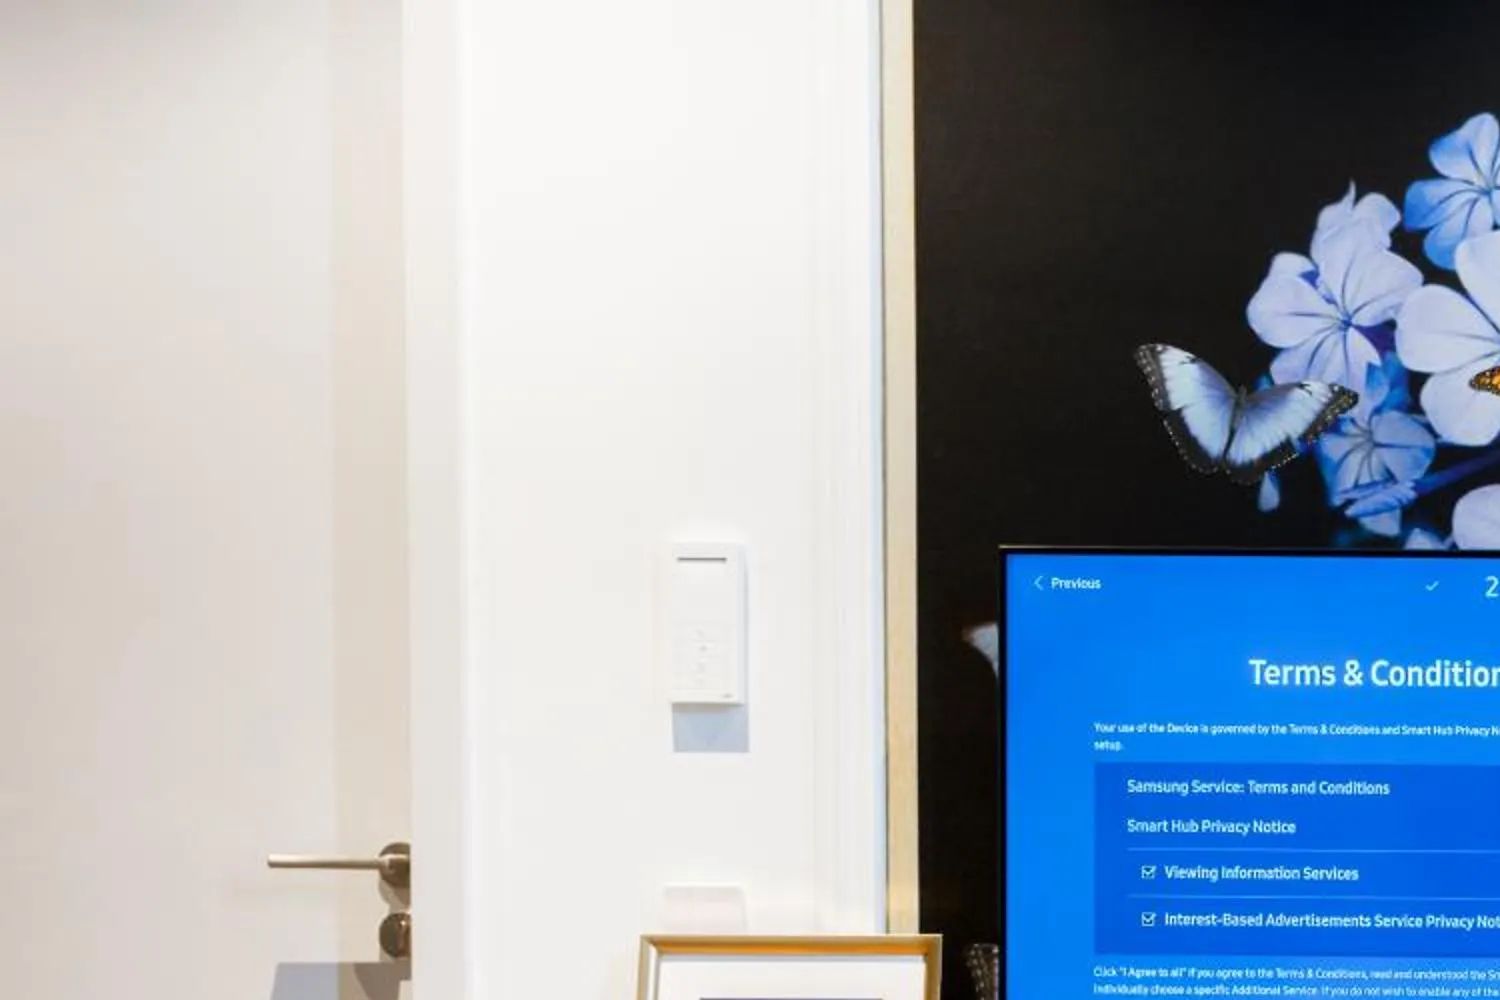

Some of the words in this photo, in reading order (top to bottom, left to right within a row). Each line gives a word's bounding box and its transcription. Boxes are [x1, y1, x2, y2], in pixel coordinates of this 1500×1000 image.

[1050, 576, 1102, 590] Previous
[1485, 575, 1500, 598] 2
[1248, 658, 1337, 687] Terms
[1342, 659, 1364, 687] &
[1094, 723, 1117, 733] Your
[1118, 723, 1134, 733] use
[1136, 723, 1147, 733] of
[1149, 723, 1165, 733] the
[1167, 724, 1198, 734] Device
[1211, 724, 1256, 736] governed
[1258, 724, 1269, 737] by
[1271, 724, 1287, 734] the
[1288, 724, 1318, 734] Terms
[1320, 724, 1328, 734] &
[1330, 725, 1380, 735] Conditions
[1382, 725, 1400, 735] and
[1401, 725, 1431, 735] Smart
[1433, 725, 1452, 735] Hub
[1455, 725, 1490, 738] Privacy
[1127, 779, 1190, 797] Samsung
[1191, 779, 1245, 794] Service:
[1247, 779, 1289, 795] Terms
[1289, 780, 1317, 795] and
[1318, 780, 1391, 795] Conditions
[1127, 819, 1169, 833] Smart
[1171, 818, 1200, 833] Hub
[1201, 819, 1251, 836] Privacy
[1252, 819, 1297, 834] Notice
[1164, 865, 1219, 883] Viewing
[1221, 865, 1301, 880] Information
[1303, 866, 1360, 881] Services
[1164, 912, 1264, 927] Interest-Based
[1265, 913, 1372, 928] Advertisements
[1373, 913, 1424, 928] Service
[1425, 914, 1476, 932] Privacy
